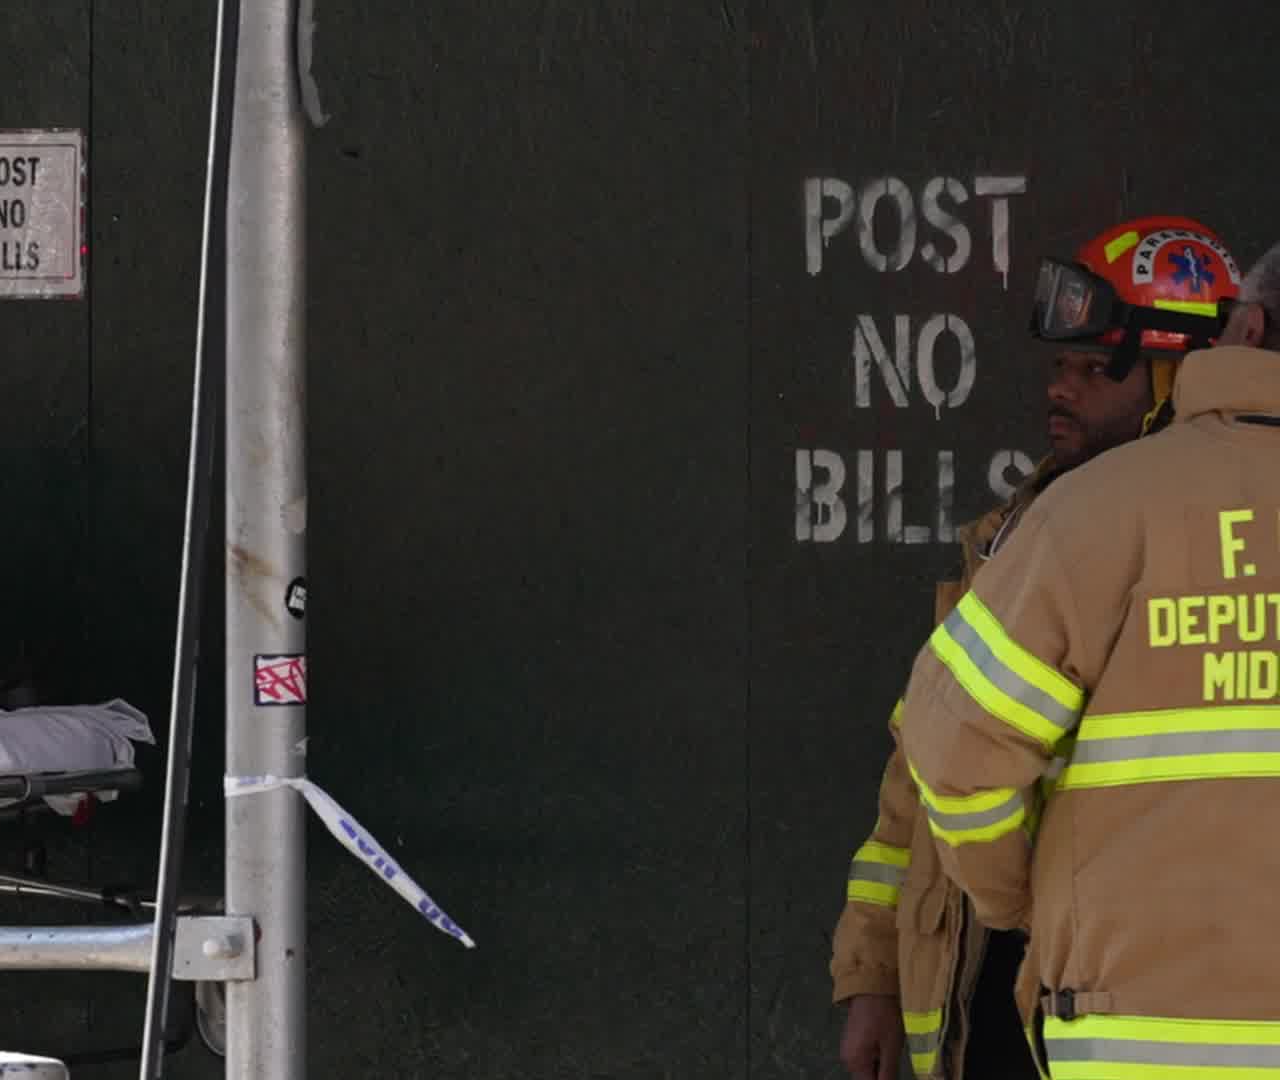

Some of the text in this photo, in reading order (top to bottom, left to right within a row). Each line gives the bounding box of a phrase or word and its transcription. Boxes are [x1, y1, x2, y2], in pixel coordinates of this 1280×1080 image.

[804, 175, 1028, 278] POST
[852, 313, 978, 412] NO
[1148, 593, 1280, 647] DEPUT
